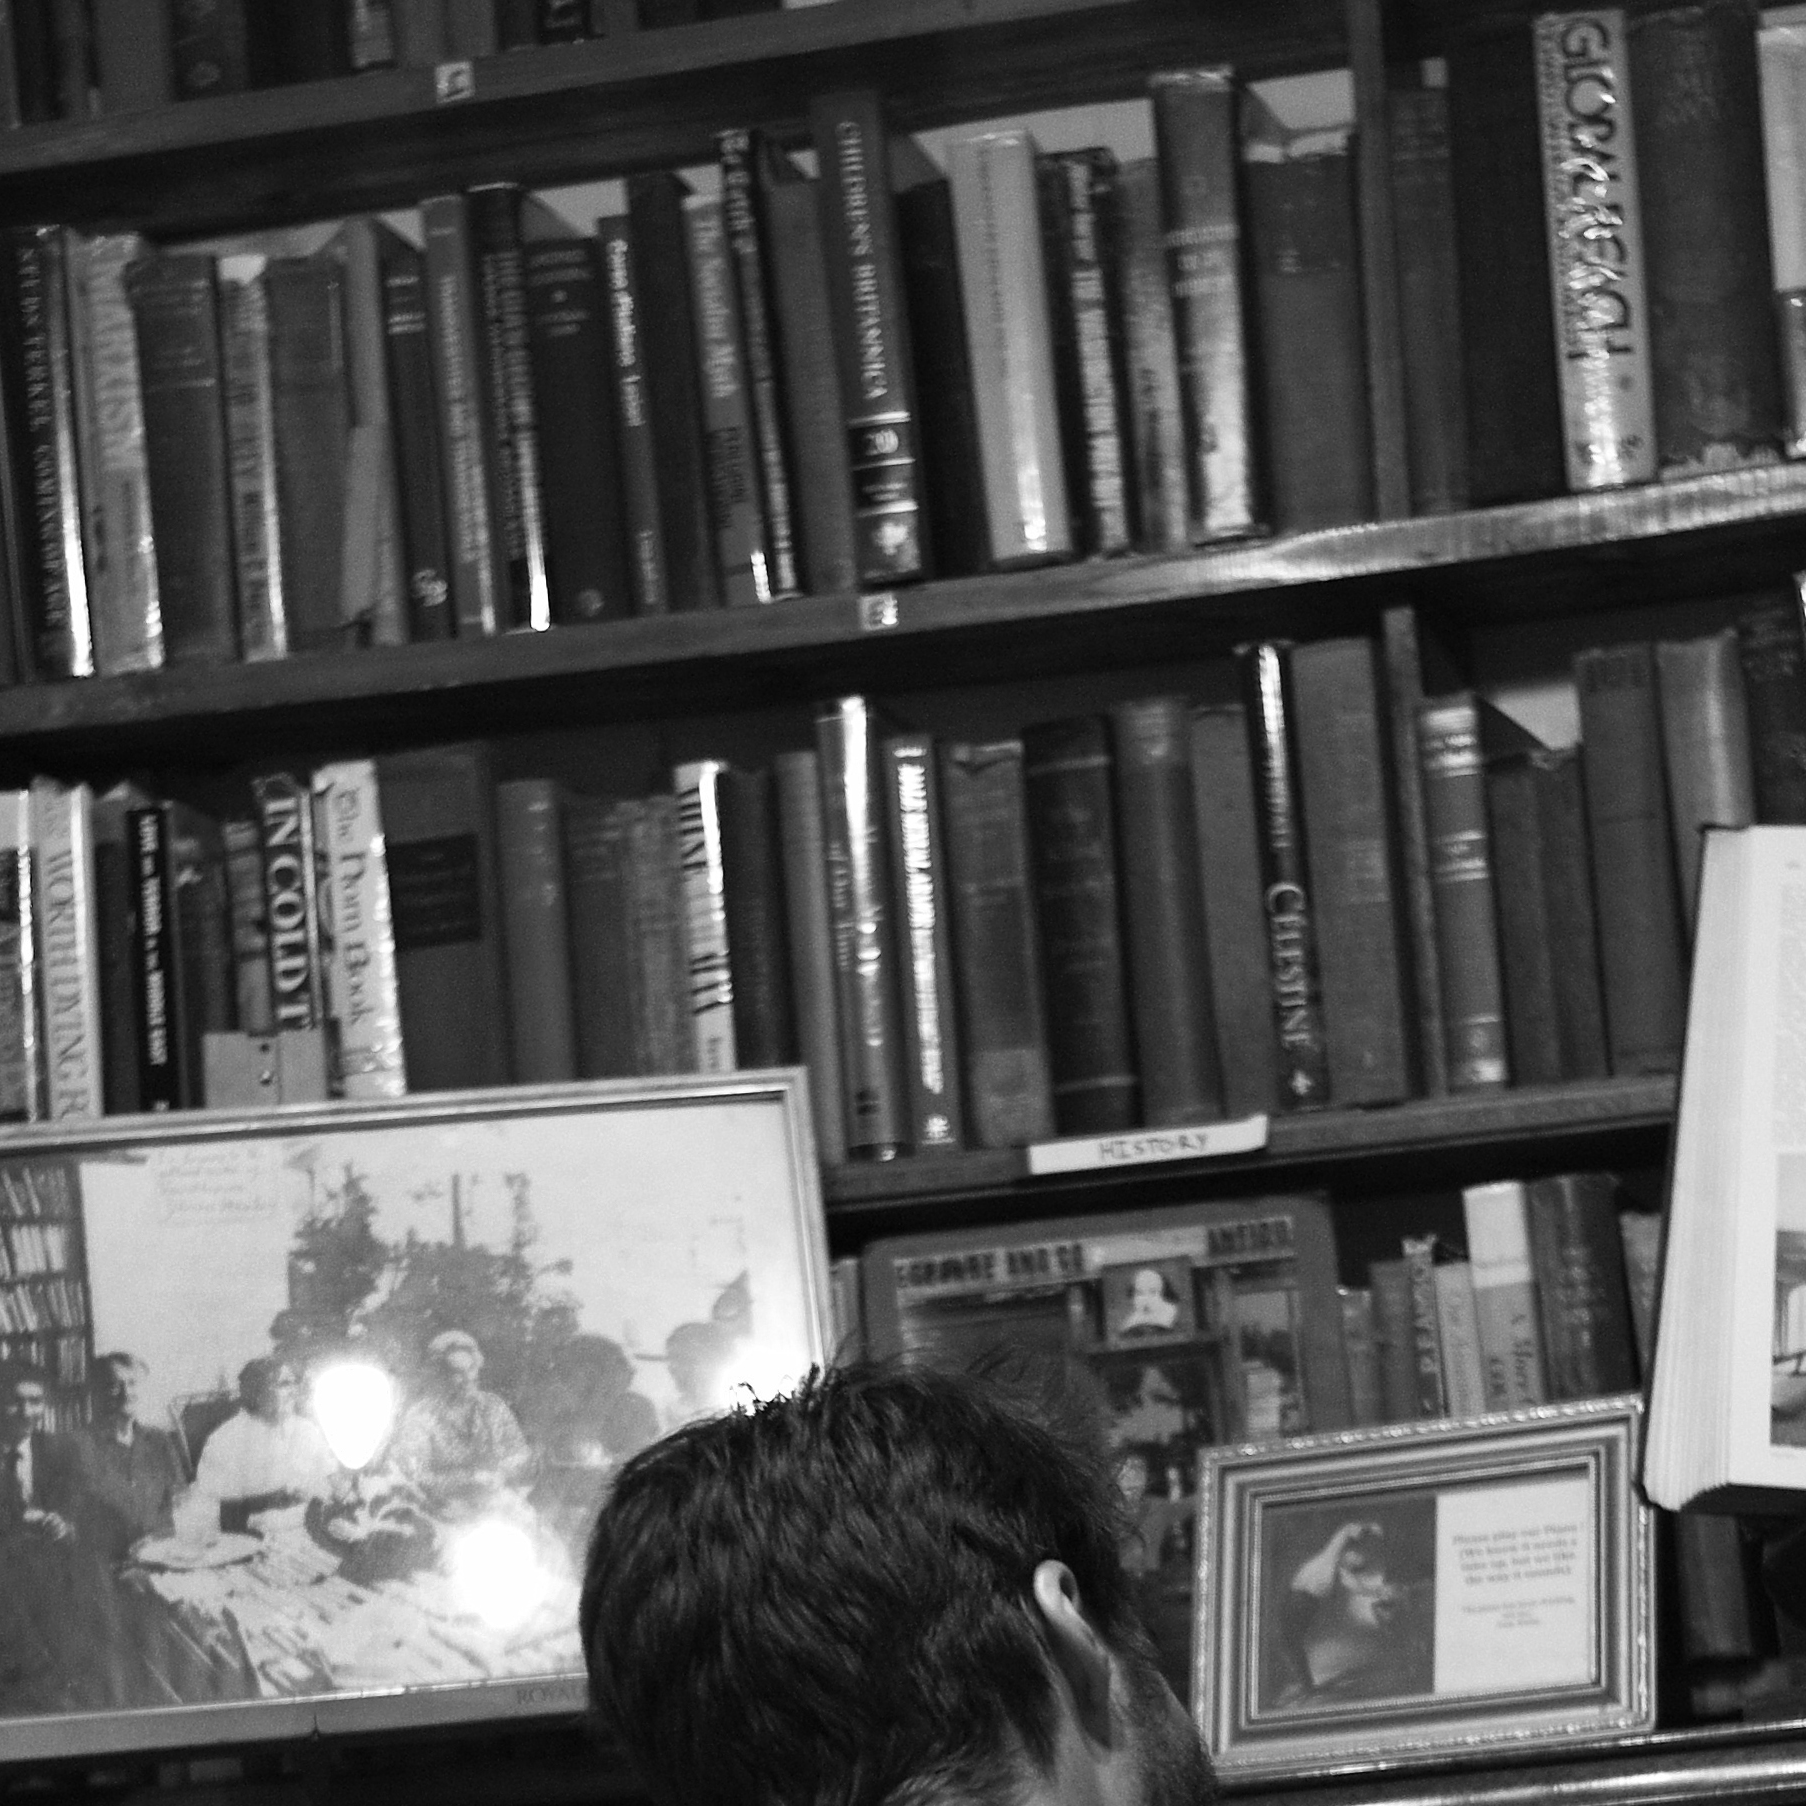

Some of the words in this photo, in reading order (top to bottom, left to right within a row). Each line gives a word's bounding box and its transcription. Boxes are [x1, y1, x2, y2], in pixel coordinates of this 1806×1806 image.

[266, 796, 300, 847] IN
[268, 851, 313, 993] COLD
[1098, 1131, 1210, 1161] HISTORY
